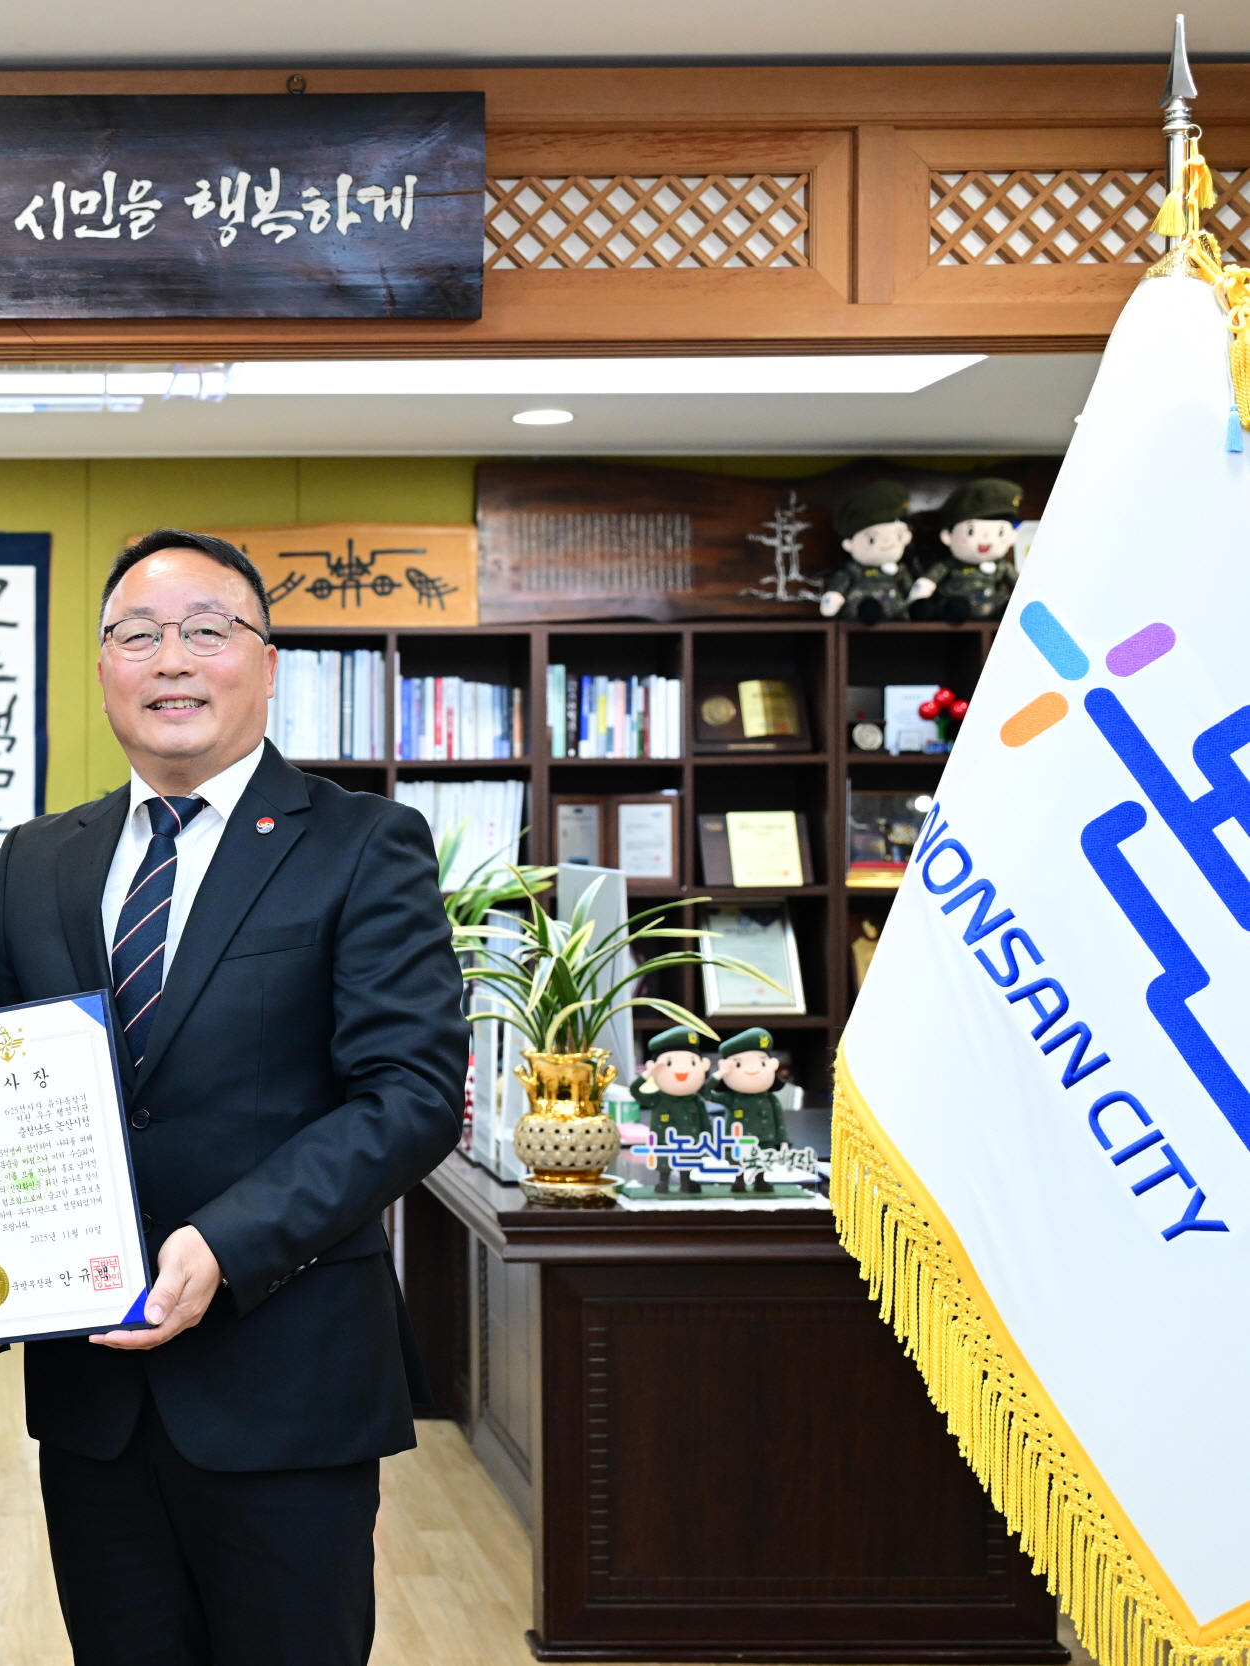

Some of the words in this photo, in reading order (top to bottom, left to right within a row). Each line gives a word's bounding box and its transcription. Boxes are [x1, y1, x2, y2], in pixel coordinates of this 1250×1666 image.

[14, 169, 163, 243] 시민을
[183, 165, 419, 247] 행복하게
[914, 801, 1112, 1090] NONSAN
[1088, 1090, 1231, 1243] CITY
[36, 1109, 52, 1120] 우수
[56, 1103, 89, 1117] 행정기관
[17, 1123, 53, 1139] 충청남도
[56, 1116, 90, 1132] 논산시청
[12, 1278, 53, 1291] 국방부장관
